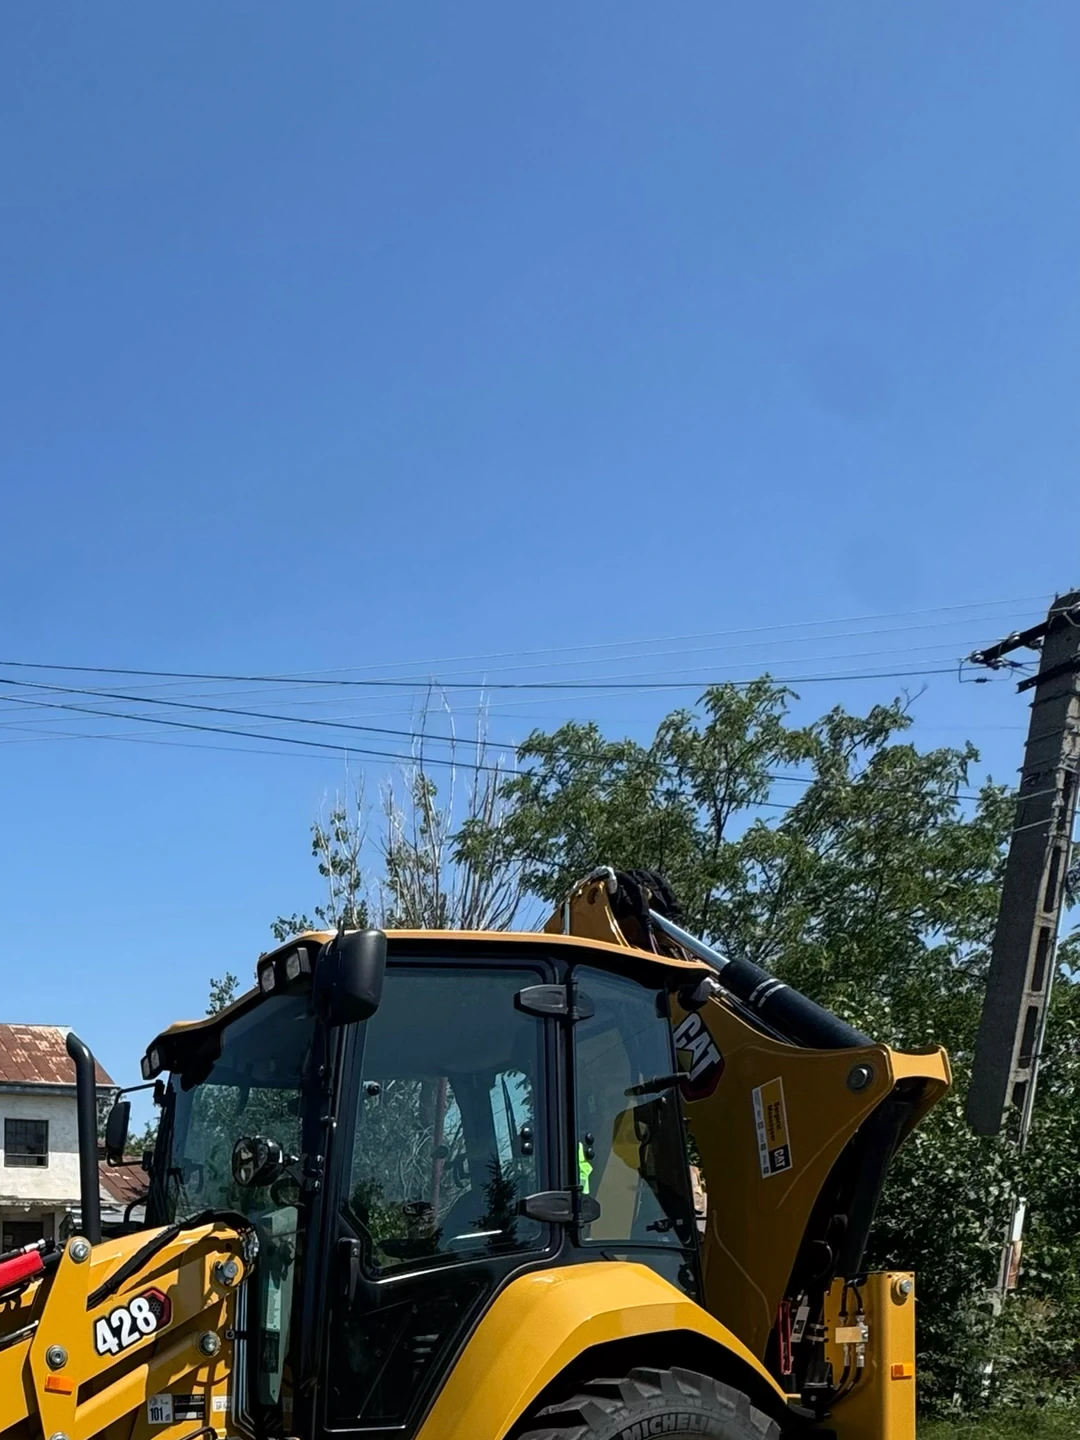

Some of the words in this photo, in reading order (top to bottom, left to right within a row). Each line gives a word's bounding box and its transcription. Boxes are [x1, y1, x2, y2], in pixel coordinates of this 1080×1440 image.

[673, 1012, 721, 1082] CAT
[773, 1148, 786, 1168] CAT
[95, 1297, 157, 1355] 428
[150, 1406, 164, 1421] 101
